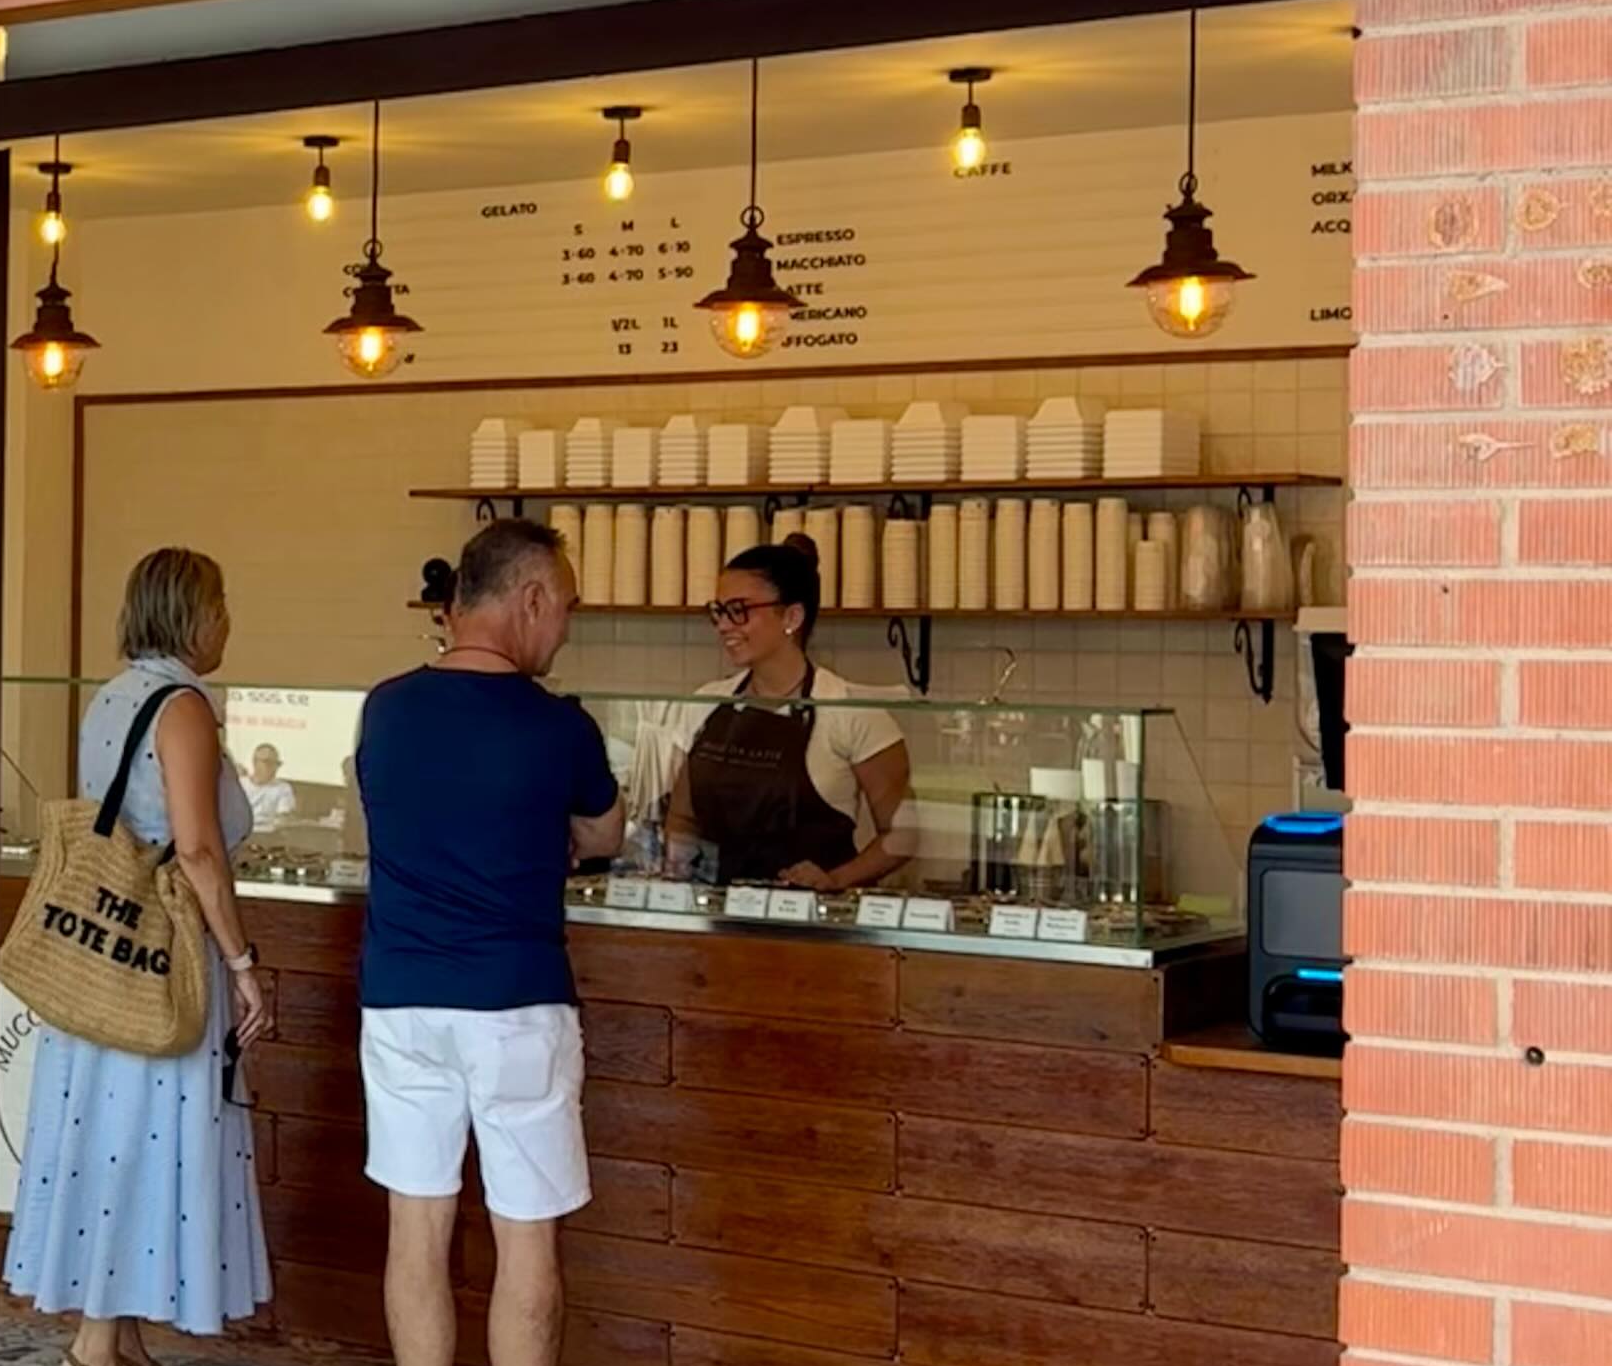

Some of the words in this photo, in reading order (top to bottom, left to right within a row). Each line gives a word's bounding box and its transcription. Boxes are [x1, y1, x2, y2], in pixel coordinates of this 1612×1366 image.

[1311, 190, 1353, 206] ORX
[481, 201, 538, 219] GELATO
[574, 223, 583, 235] S
[621, 220, 634, 232] M
[670, 217, 680, 229] L
[776, 228, 855, 246] ESPRESSO
[776, 253, 866, 271] MACCHIATO
[786, 282, 824, 295] ATTE
[781, 332, 858, 348] FFOGATO
[96, 885, 143, 931] THE
[44, 902, 109, 954] TOTE
[111, 936, 171, 975] BAG
